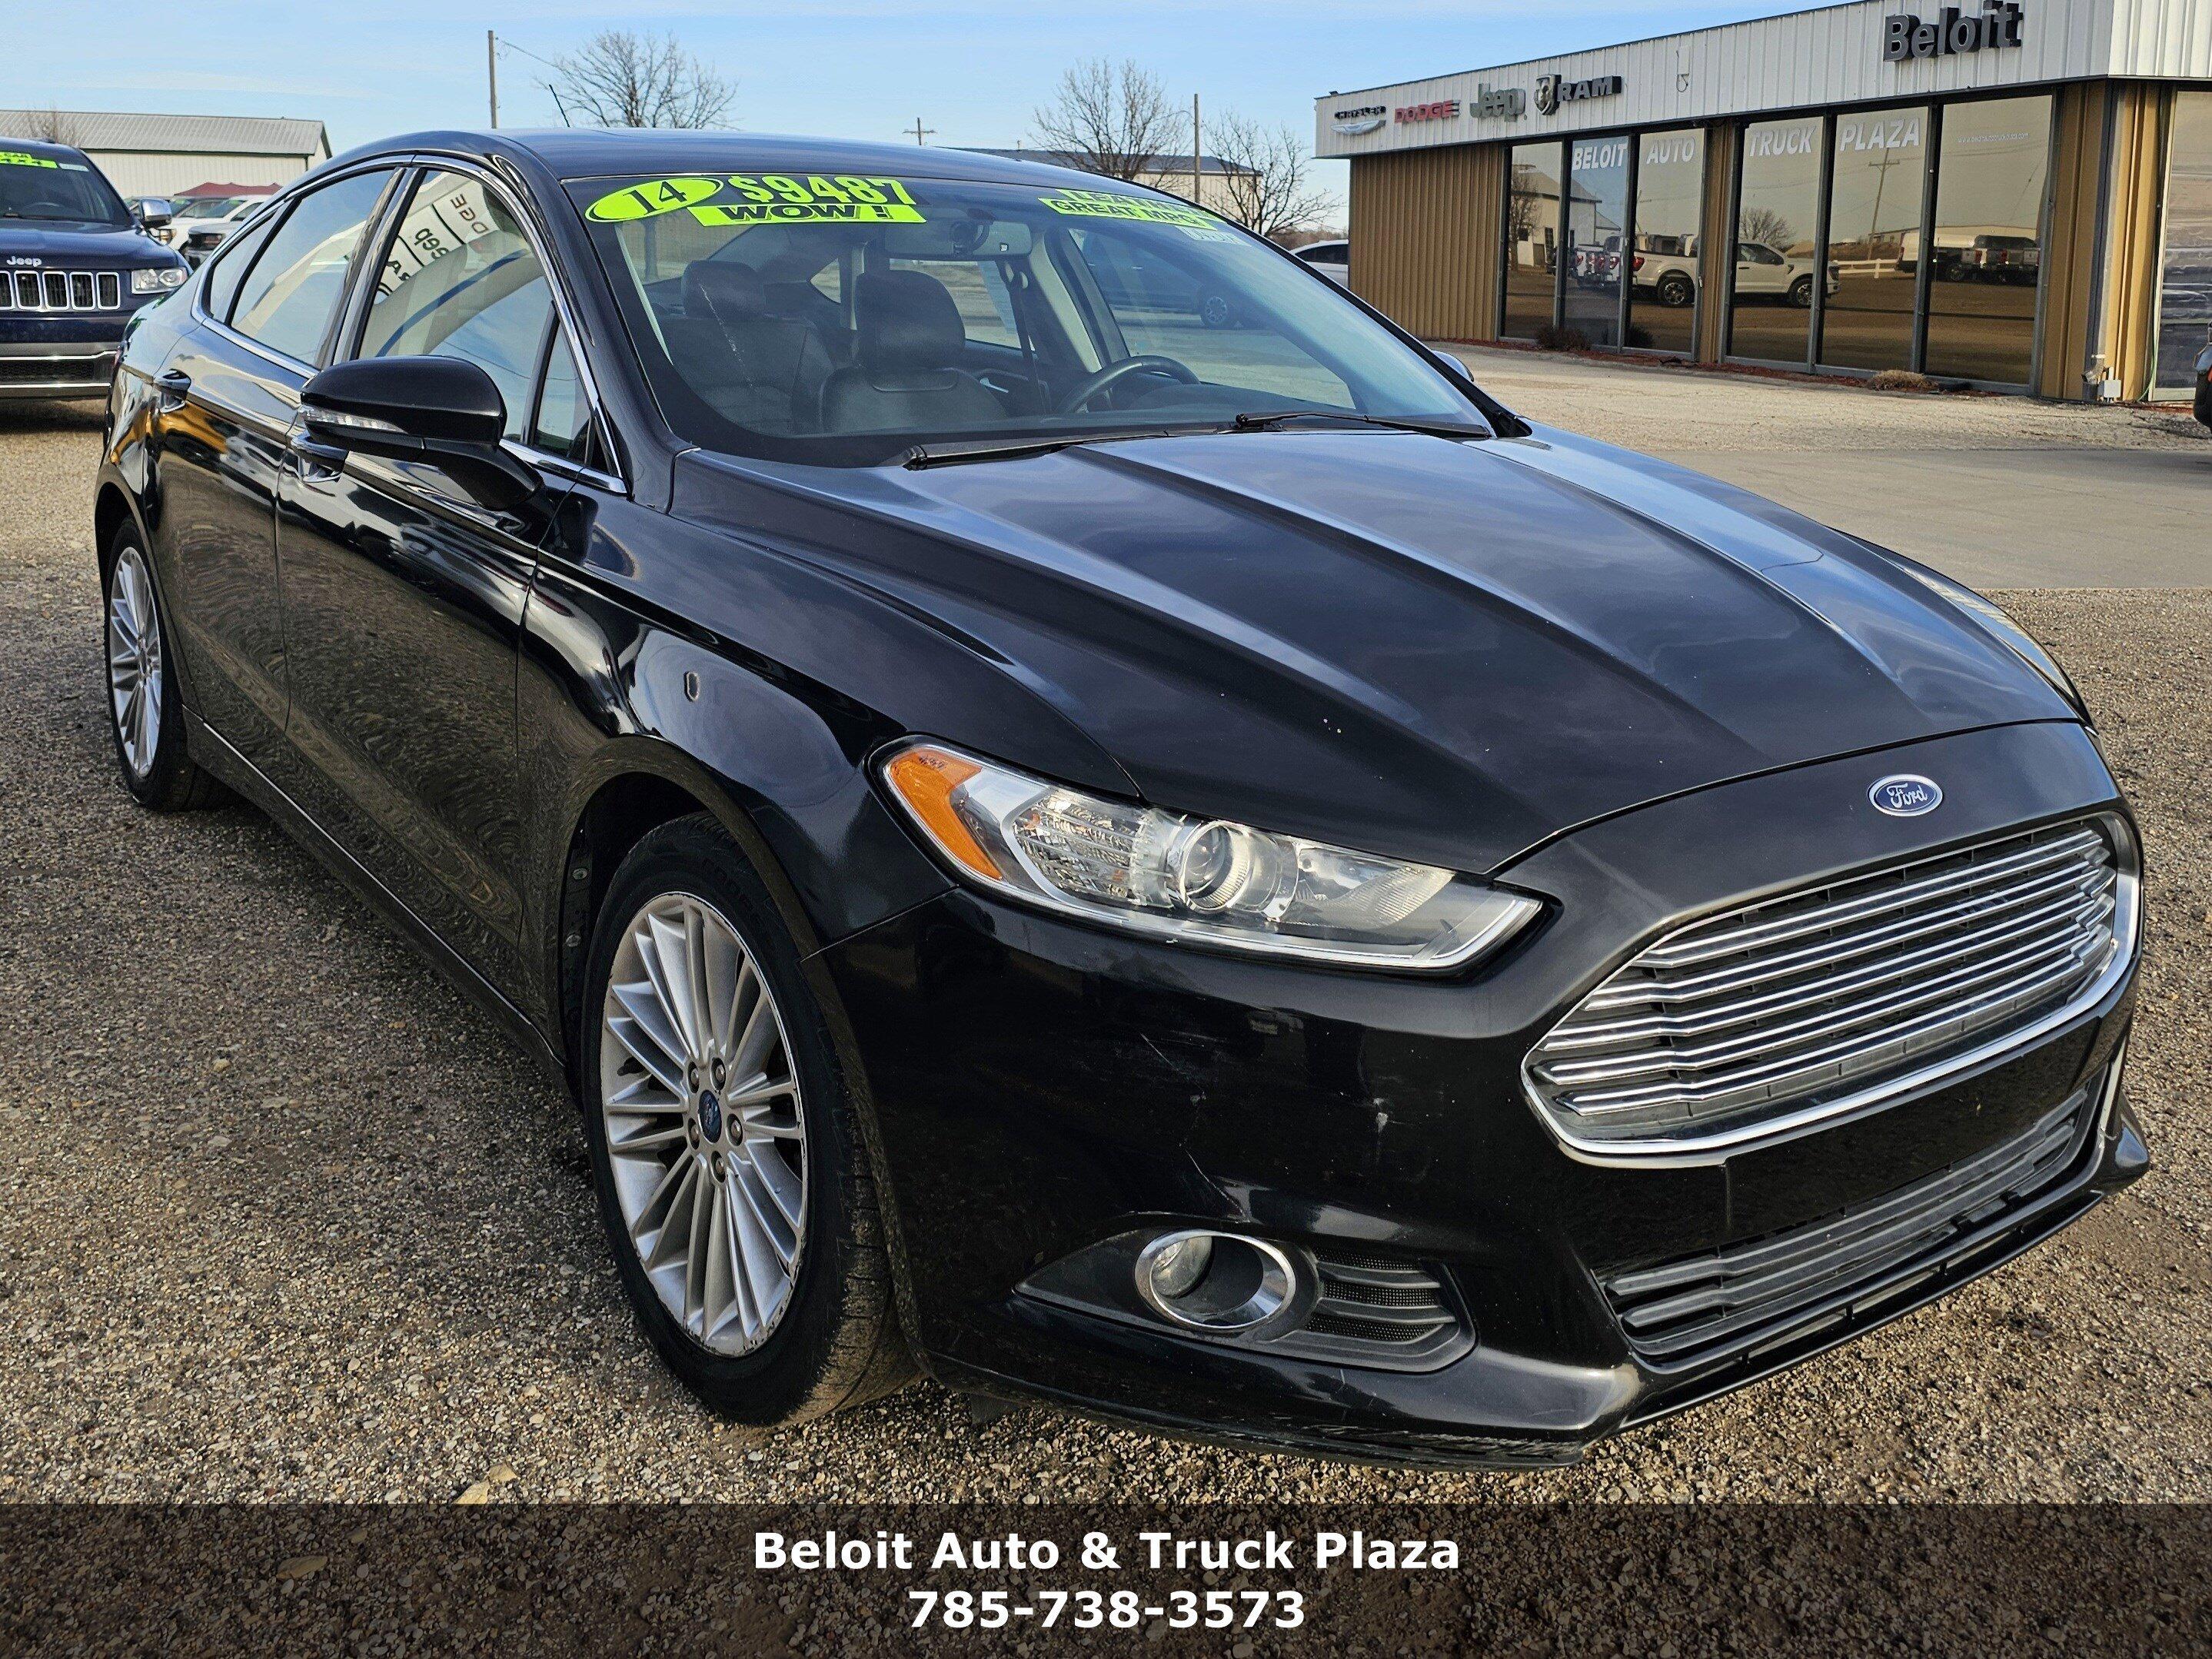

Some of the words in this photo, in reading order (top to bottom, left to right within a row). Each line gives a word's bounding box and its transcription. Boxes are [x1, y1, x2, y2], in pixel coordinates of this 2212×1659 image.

[1883, 0, 2023, 62] Beloit
[1558, 75, 1621, 101] RAM
[1334, 105, 1386, 120] CHRYSLER
[1395, 100, 1460, 123] DODGE
[1469, 83, 1525, 122] Jeep
[1572, 143, 1628, 171] BELOIT
[1646, 137, 1696, 165] AUTO
[1748, 125, 1817, 158] TRUCK
[1840, 118, 1920, 152] PLAZA
[622, 180, 687, 214] 14
[727, 175, 916, 204] $9487
[1050, 199, 1139, 218] GREAT
[1143, 208, 1206, 227] MPG
[6, 255, 42, 268] Jeep
[1886, 782, 1928, 808] Ford
